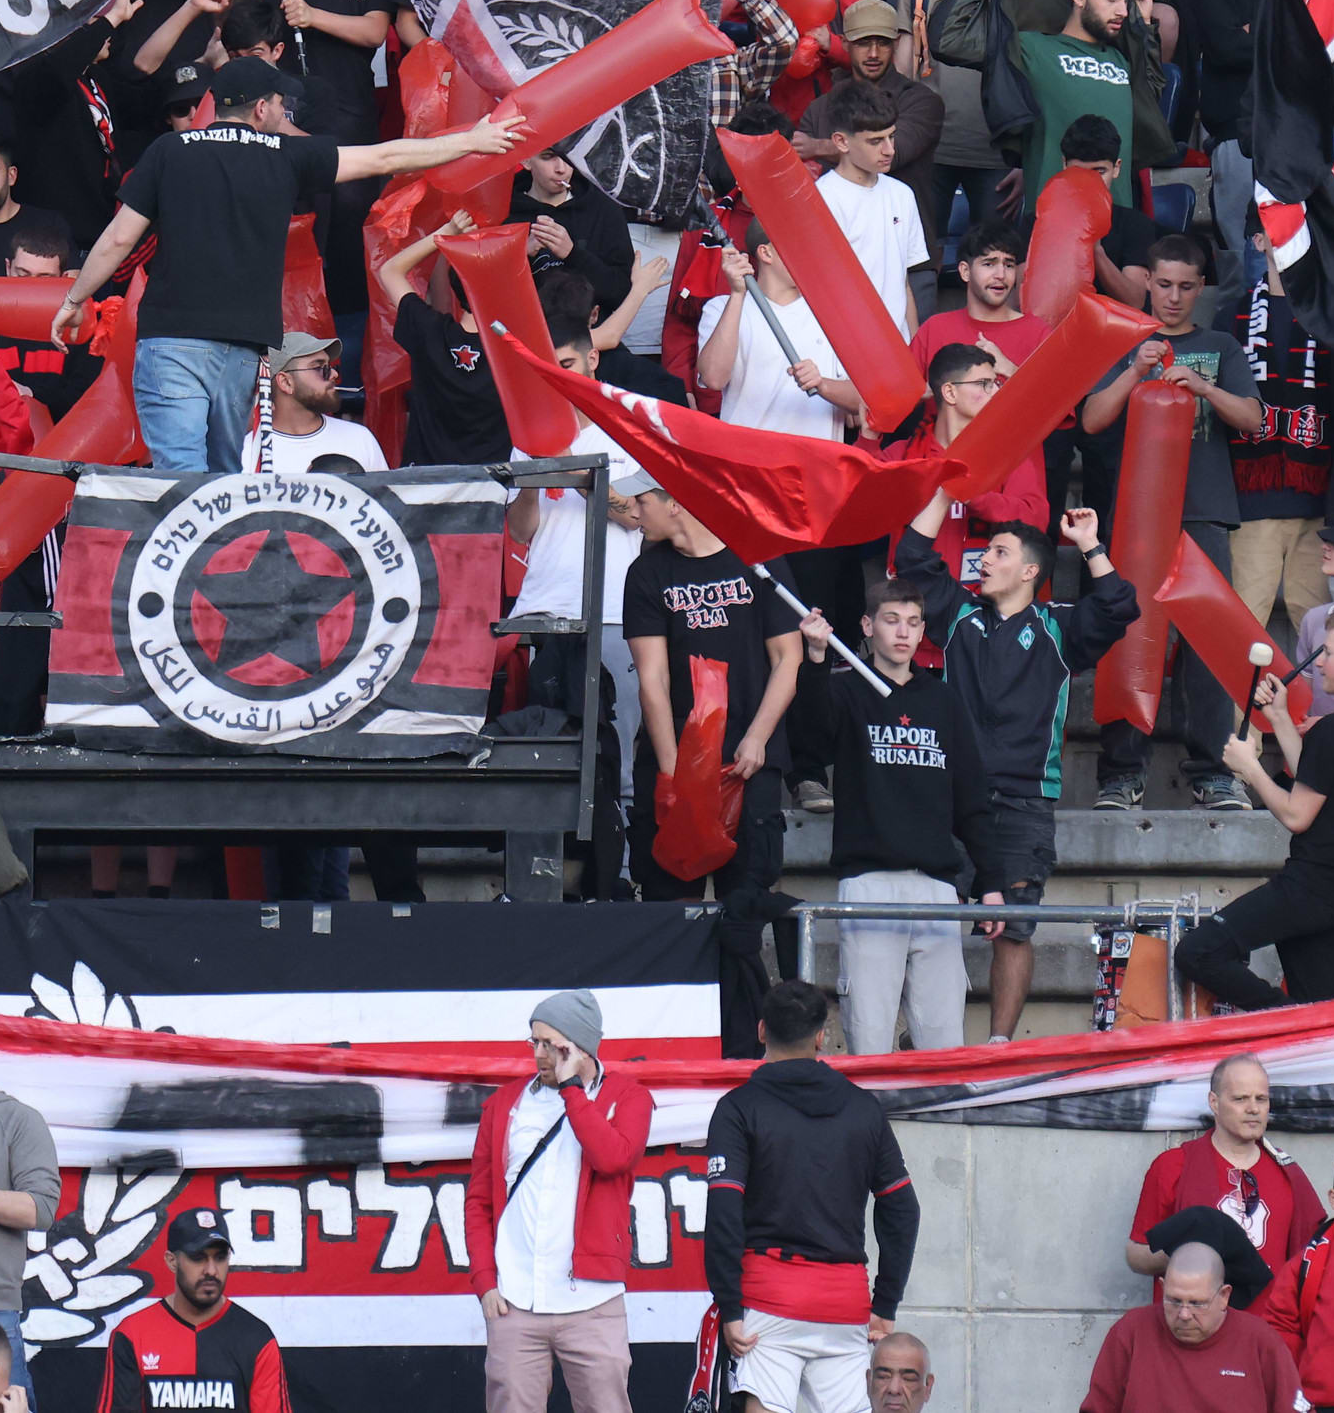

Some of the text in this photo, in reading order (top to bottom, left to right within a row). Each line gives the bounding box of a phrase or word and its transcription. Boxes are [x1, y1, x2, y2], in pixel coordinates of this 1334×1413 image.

[179, 129, 238, 146] POLIZIA
[151, 474, 405, 574] הפועל ירושלים של כולם
[662, 576, 755, 612] HAPOEL
[138, 638, 196, 695] للكل
[183, 699, 283, 732] القدس
[866, 724, 939, 750] HAPOEL
[870, 748, 947, 770] RUSALEM
[148, 1381, 236, 1410] YAMAHA
